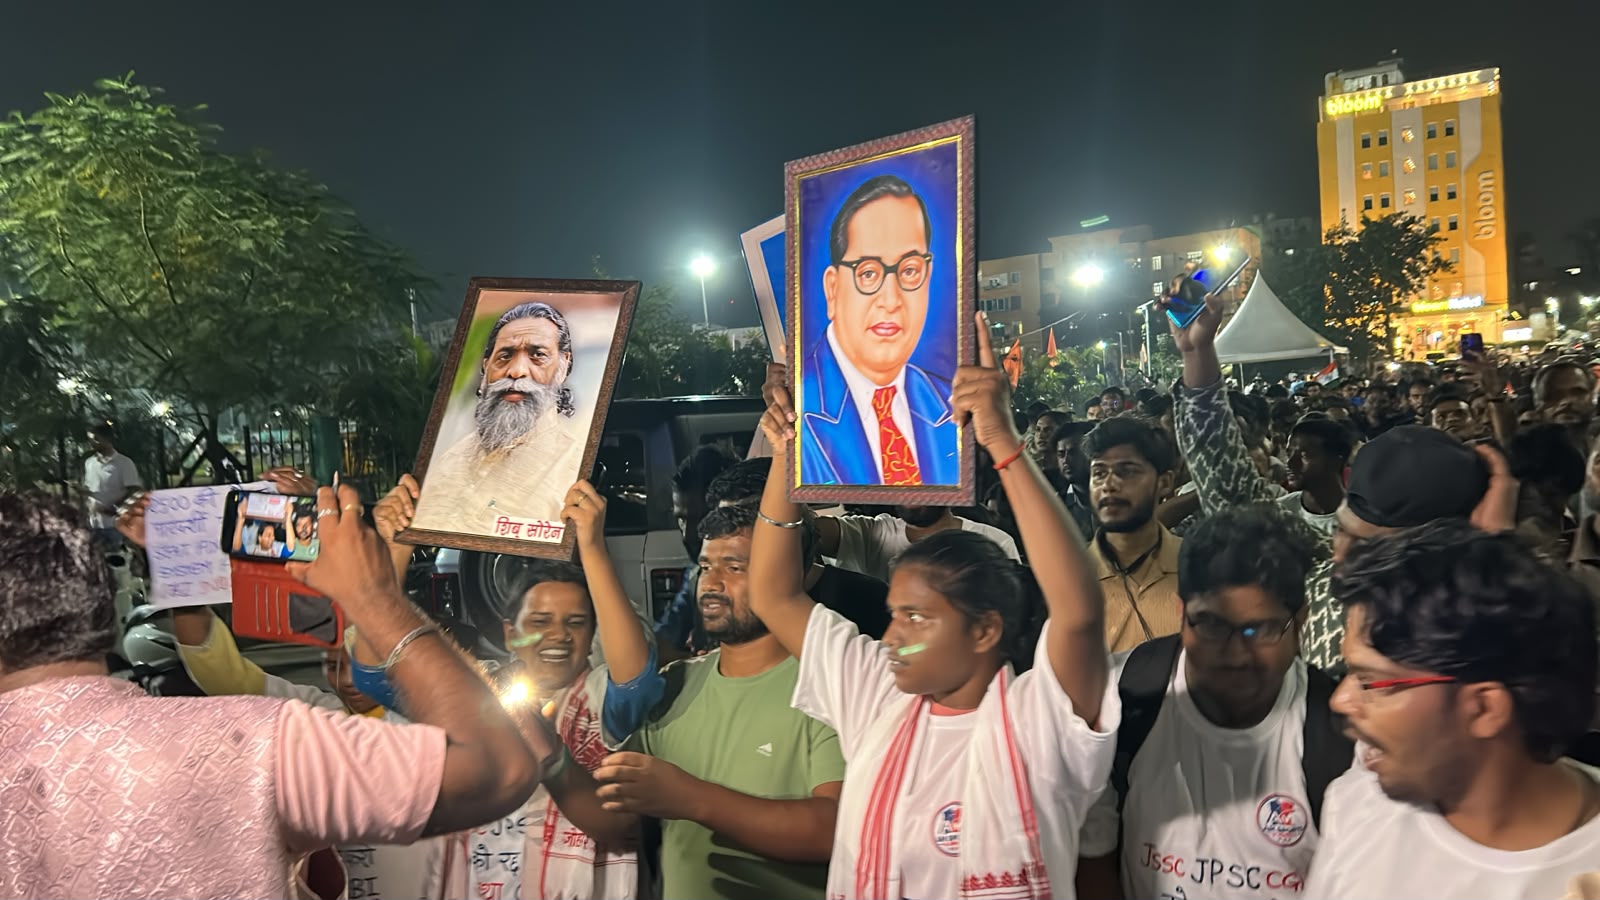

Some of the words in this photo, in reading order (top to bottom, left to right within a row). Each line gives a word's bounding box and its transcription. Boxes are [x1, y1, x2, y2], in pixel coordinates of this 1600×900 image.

[1326, 96, 1382, 115] bloom
[1473, 169, 1496, 240] bloom
[526, 520, 565, 540] सोरेन
[1190, 858, 1261, 890] JPSC
